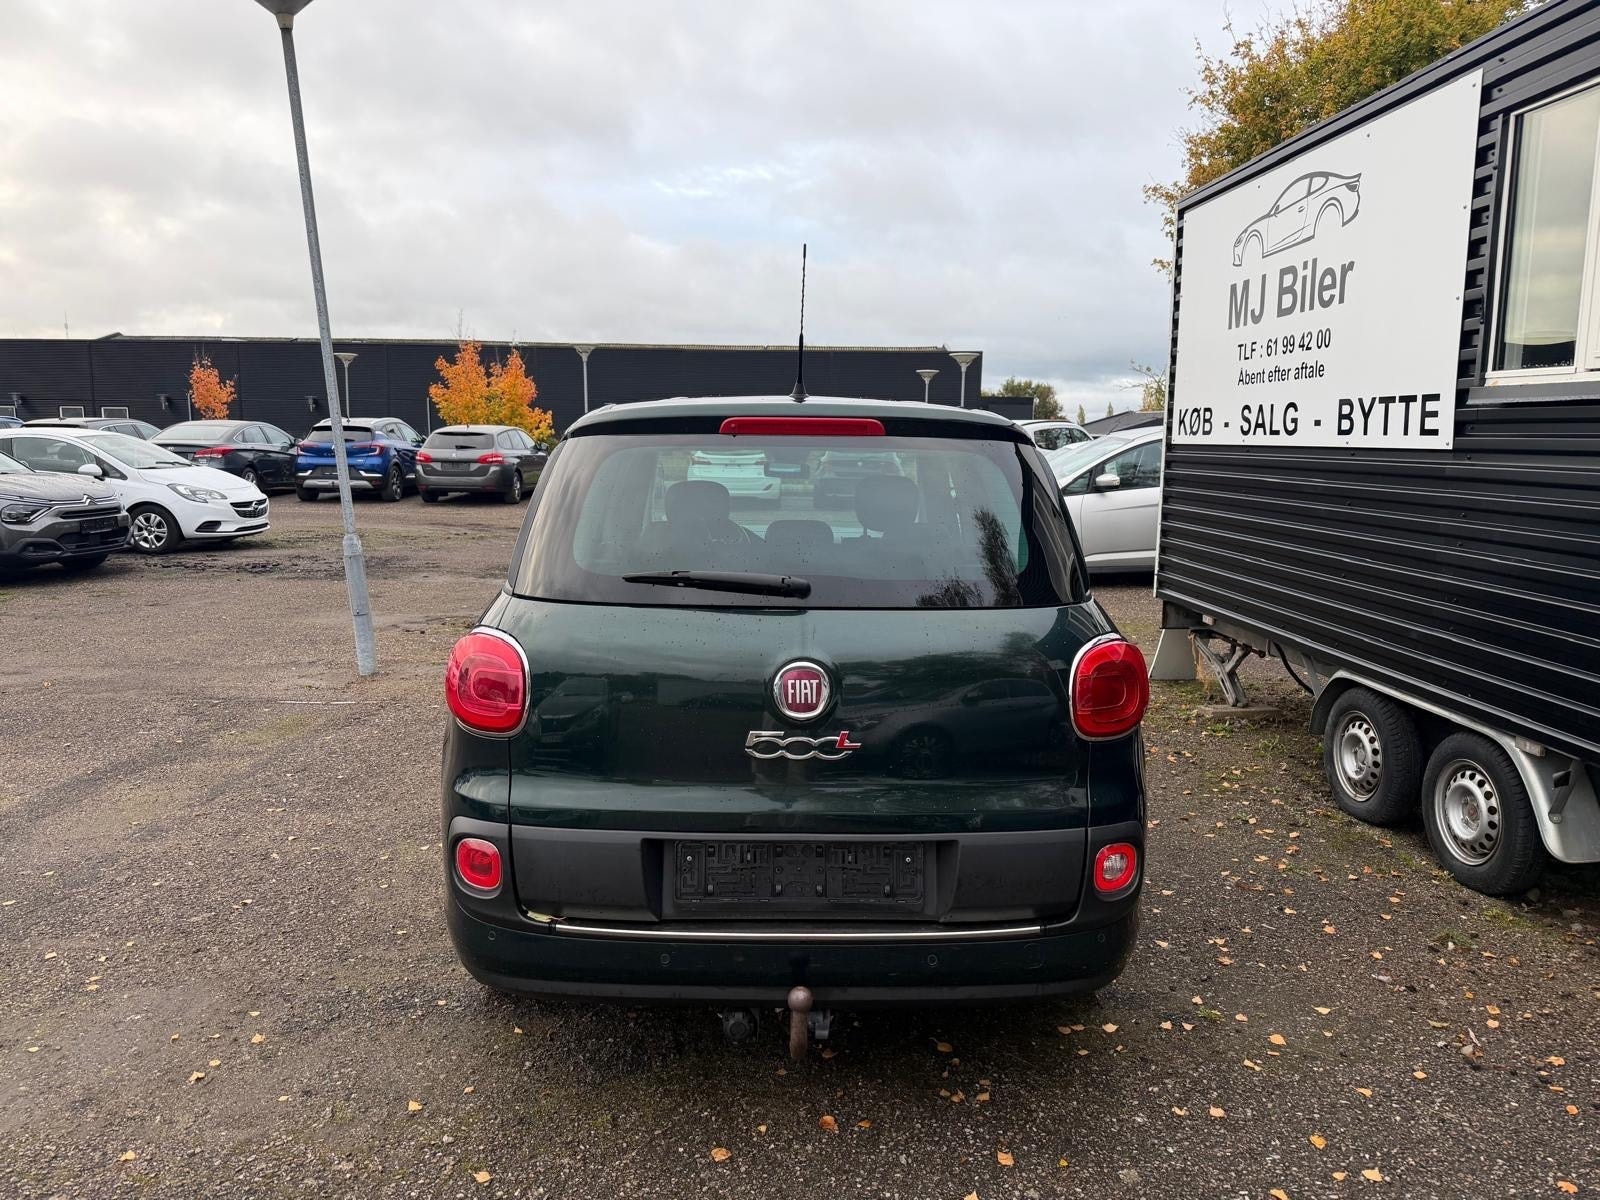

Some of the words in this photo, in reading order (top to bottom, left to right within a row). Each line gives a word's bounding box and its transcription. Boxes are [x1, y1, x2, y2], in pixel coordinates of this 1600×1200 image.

[1227, 274, 1267, 330] MJ
[1276, 257, 1355, 319] Biler
[1237, 341, 1257, 361] TLF
[1266, 337, 1278, 357] 61
[1282, 334, 1296, 355] 99
[1298, 331, 1313, 352] 42
[1316, 327, 1332, 350] 00
[1237, 367, 1266, 386] Åbent
[1267, 365, 1292, 383] efter
[1293, 360, 1325, 380] aftale
[1178, 407, 1214, 437] KØB
[1239, 402, 1299, 437] SALG
[1336, 393, 1441, 437] BYTTE
[787, 679, 820, 704] FIAT
[744, 730, 862, 761] 500L
